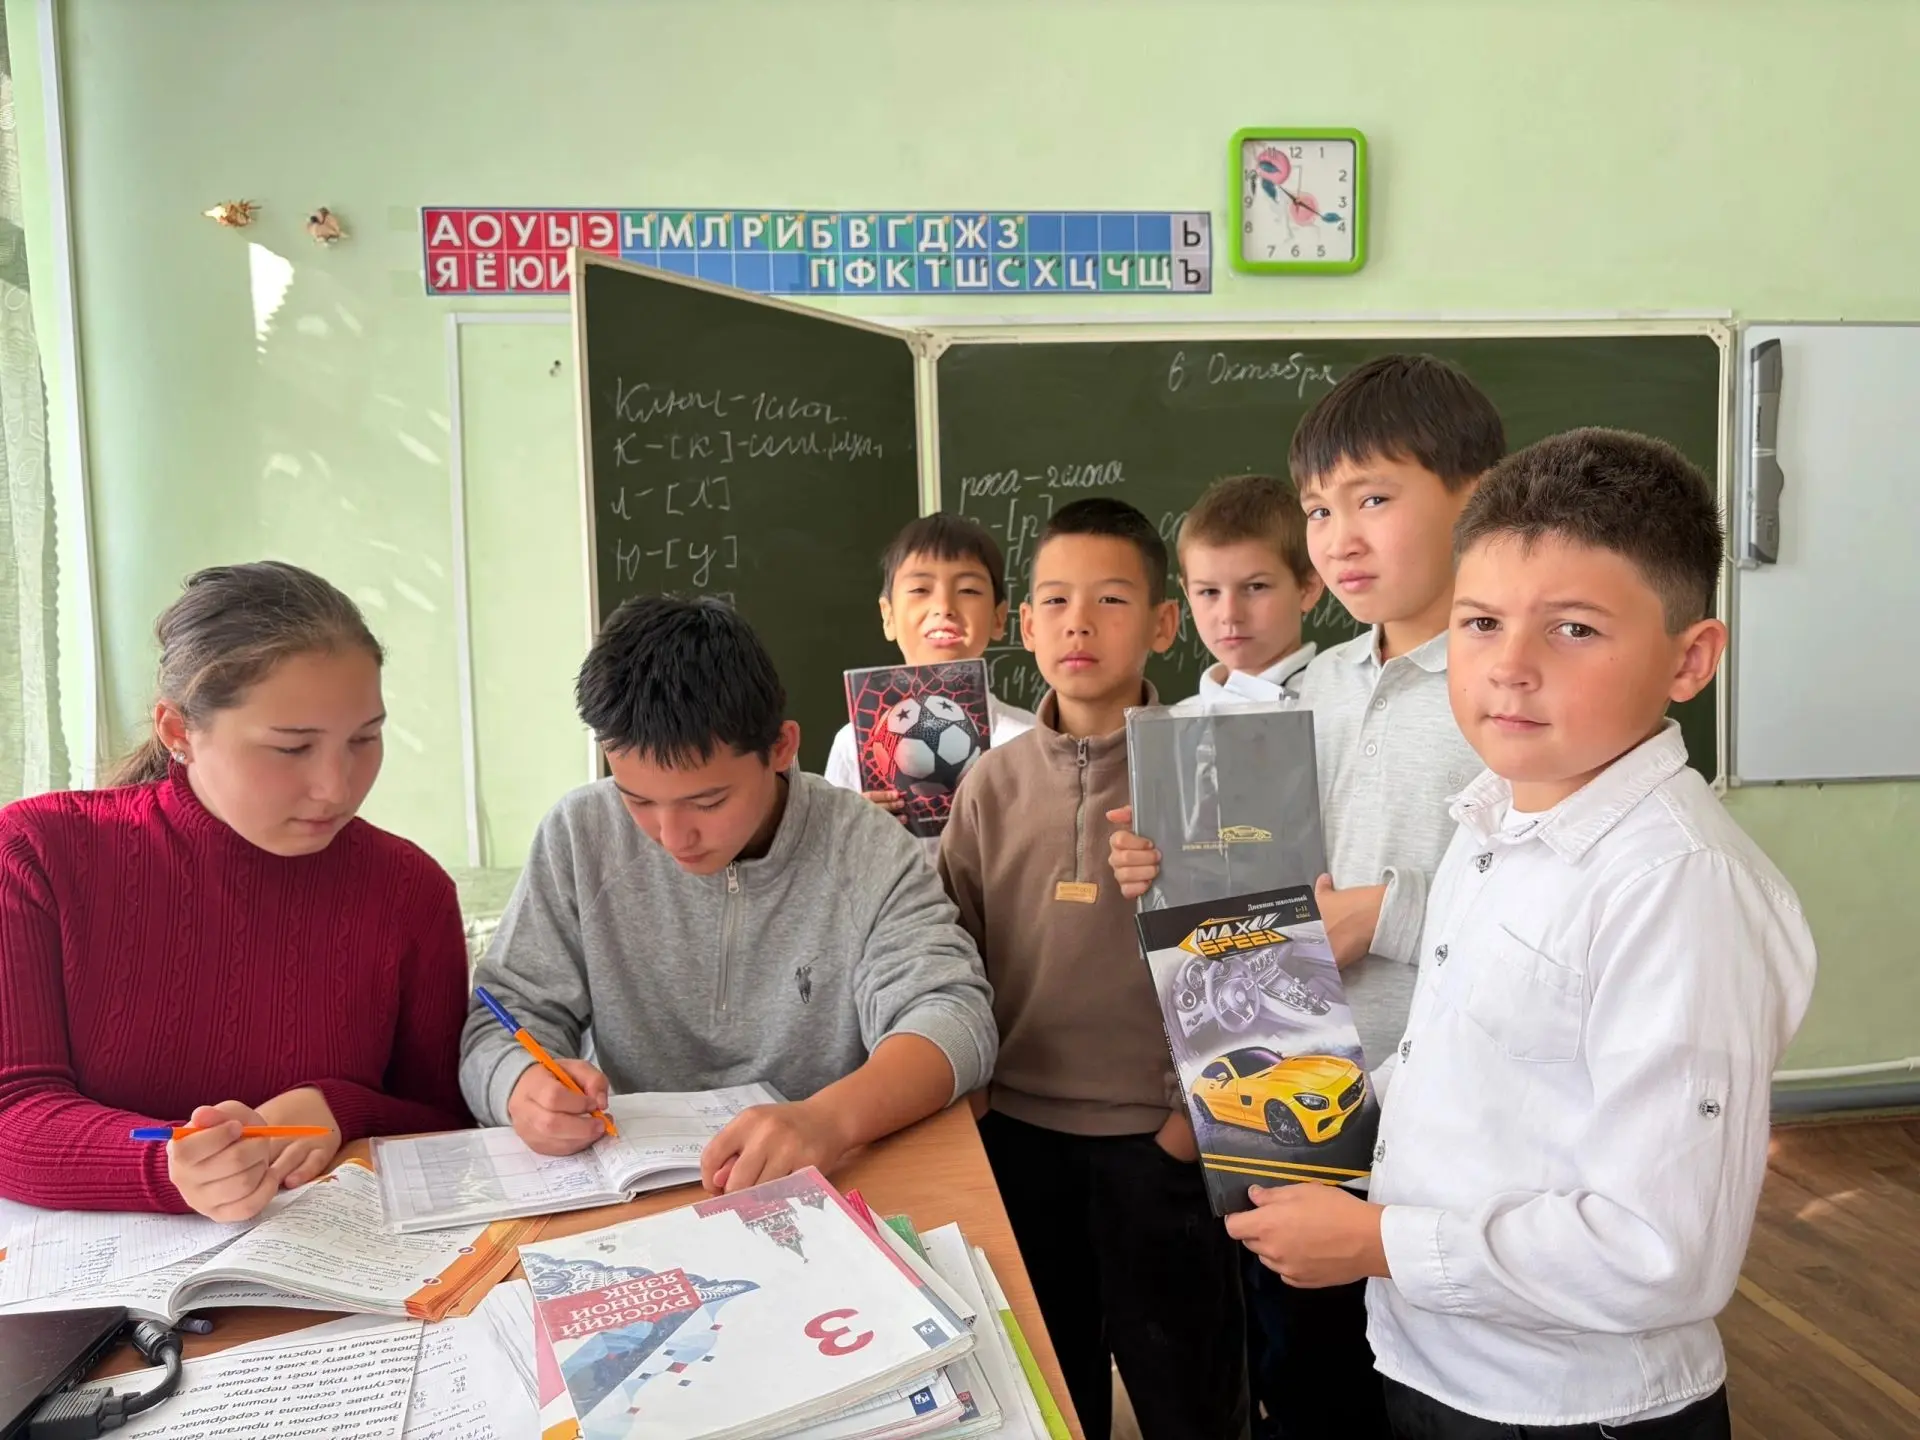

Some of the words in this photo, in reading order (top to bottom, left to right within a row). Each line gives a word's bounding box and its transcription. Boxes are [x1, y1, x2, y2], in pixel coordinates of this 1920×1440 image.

[1289, 147, 1302, 158] 12
[1338, 170, 1347, 182] 2
[1244, 196, 1253, 208] 9
[1338, 196, 1347, 208] 3
[430, 215, 462, 247] А
[468, 215, 502, 248] О
[510, 216, 537, 247] У
[549, 216, 580, 248] Ы
[589, 216, 614, 248] Э
[624, 216, 650, 248] Н
[660, 216, 695, 248] М
[700, 217, 730, 248] Л
[743, 217, 763, 248] Р
[776, 214, 804, 248] Й
[812, 219, 834, 249] Б
[850, 219, 870, 249] В
[888, 219, 908, 249] Г
[918, 219, 948, 252] Д
[955, 219, 987, 249] Ж
[998, 219, 1019, 249] З
[1184, 220, 1201, 247] Ь
[1244, 222, 1253, 234] 8
[1338, 222, 1346, 232] 4
[1267, 245, 1276, 258] 7
[1290, 245, 1300, 257] 6
[1316, 245, 1326, 257] 5
[436, 256, 458, 288] Я
[476, 253, 497, 288] Ё
[509, 256, 544, 288] Ю
[811, 259, 835, 287] П
[844, 258, 876, 288] Ф
[886, 259, 909, 288] К
[924, 259, 946, 287] Т
[956, 259, 988, 287] Ш
[996, 259, 1018, 288] С
[1034, 259, 1056, 287] Х
[1070, 259, 1096, 290] Ц
[1107, 259, 1128, 287] Ч
[1138, 259, 1171, 290] Щ
[1178, 259, 1201, 286] Ъ
[1198, 928, 1289, 956] SPEED
[600, 1272, 678, 1300] ЯЗЫК
[569, 1282, 686, 1321] РОДНОЙ
[560, 1294, 692, 1337] РУССКИЙ
[804, 1308, 874, 1356] 3
[350, 1338, 390, 1348] земля
[278, 1348, 322, 1360] горсти
[322, 1352, 365, 1364] ответу
[218, 1367, 260, 1378] обеду.
[274, 1362, 307, 1372] хлеб
[322, 1360, 376, 1375] песенки
[366, 1366, 414, 1378] Уменье
[287, 1370, 318, 1380] поёт
[319, 1376, 348, 1386] труд
[216, 1376, 269, 1388] орешки
[341, 1378, 410, 1394] Наступила
[224, 1385, 288, 1398] перетрут.
[296, 1390, 336, 1400] осень
[232, 1398, 278, 1408] пошли
[346, 1392, 384, 1405] траве
[180, 1403, 229, 1418] дожди.
[278, 1401, 342, 1414] сверкала
[170, 1412, 260, 1430] серебрилась
[288, 1413, 340, 1425] сороки
[129, 1426, 166, 1440] роса.
[208, 1422, 270, 1436] прыгали
[332, 1422, 360, 1433] ещё
